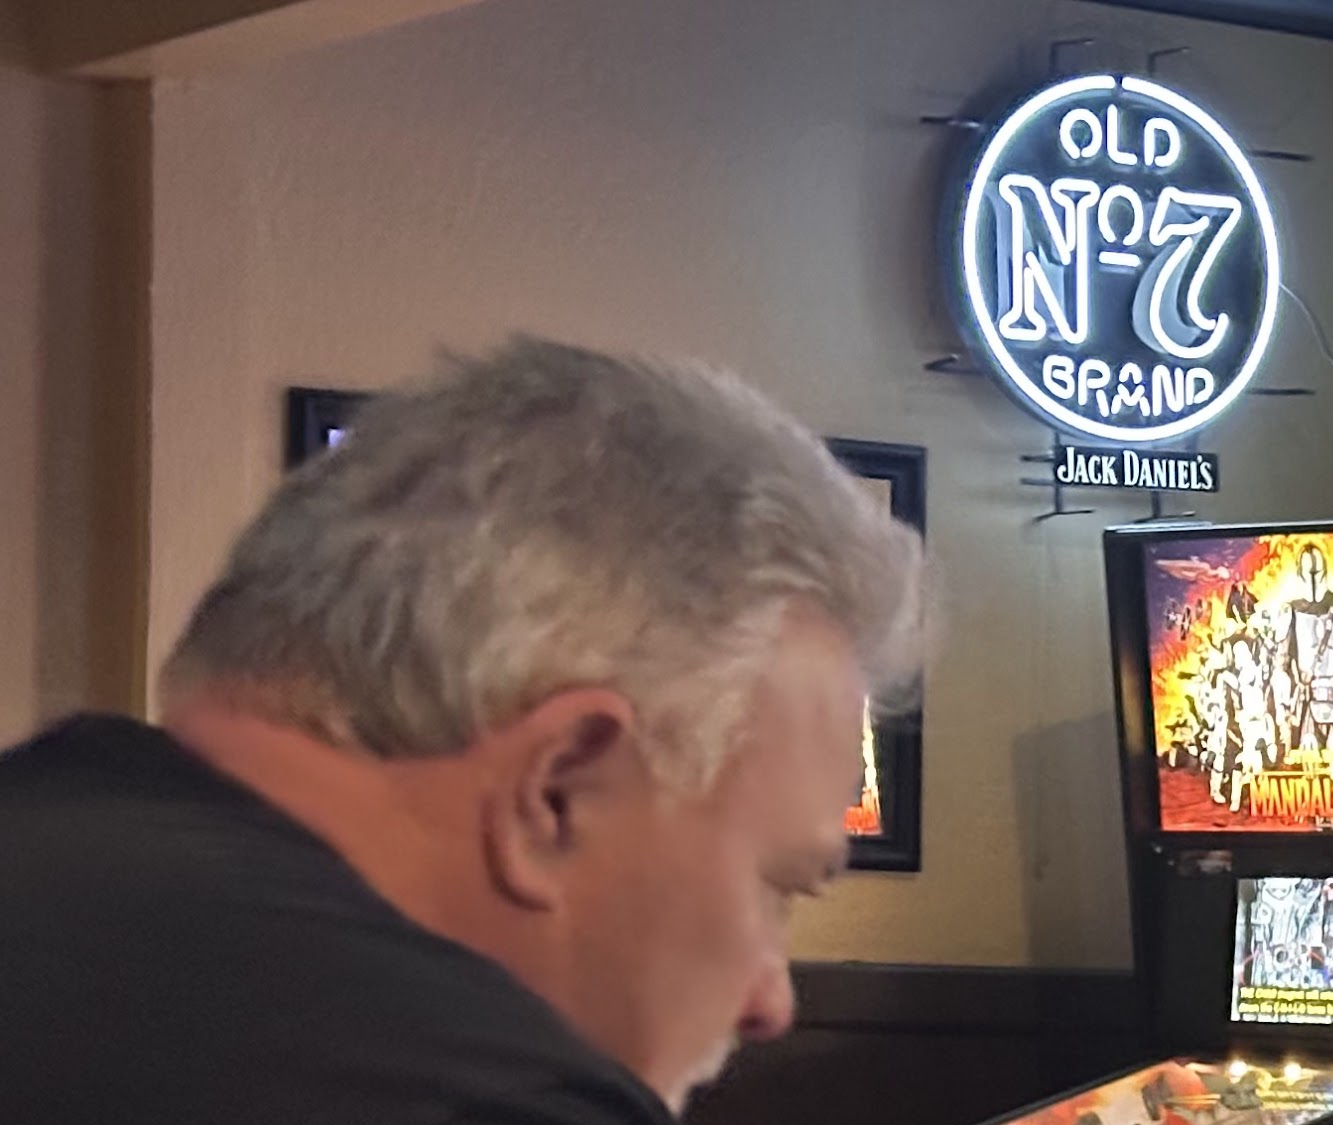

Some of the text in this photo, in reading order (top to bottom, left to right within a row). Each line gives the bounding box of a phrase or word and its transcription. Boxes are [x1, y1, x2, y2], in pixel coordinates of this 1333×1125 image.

[1059, 106, 1181, 166] OLD
[1042, 355, 1214, 418] BRAND
[1057, 446, 1119, 487] JACK
